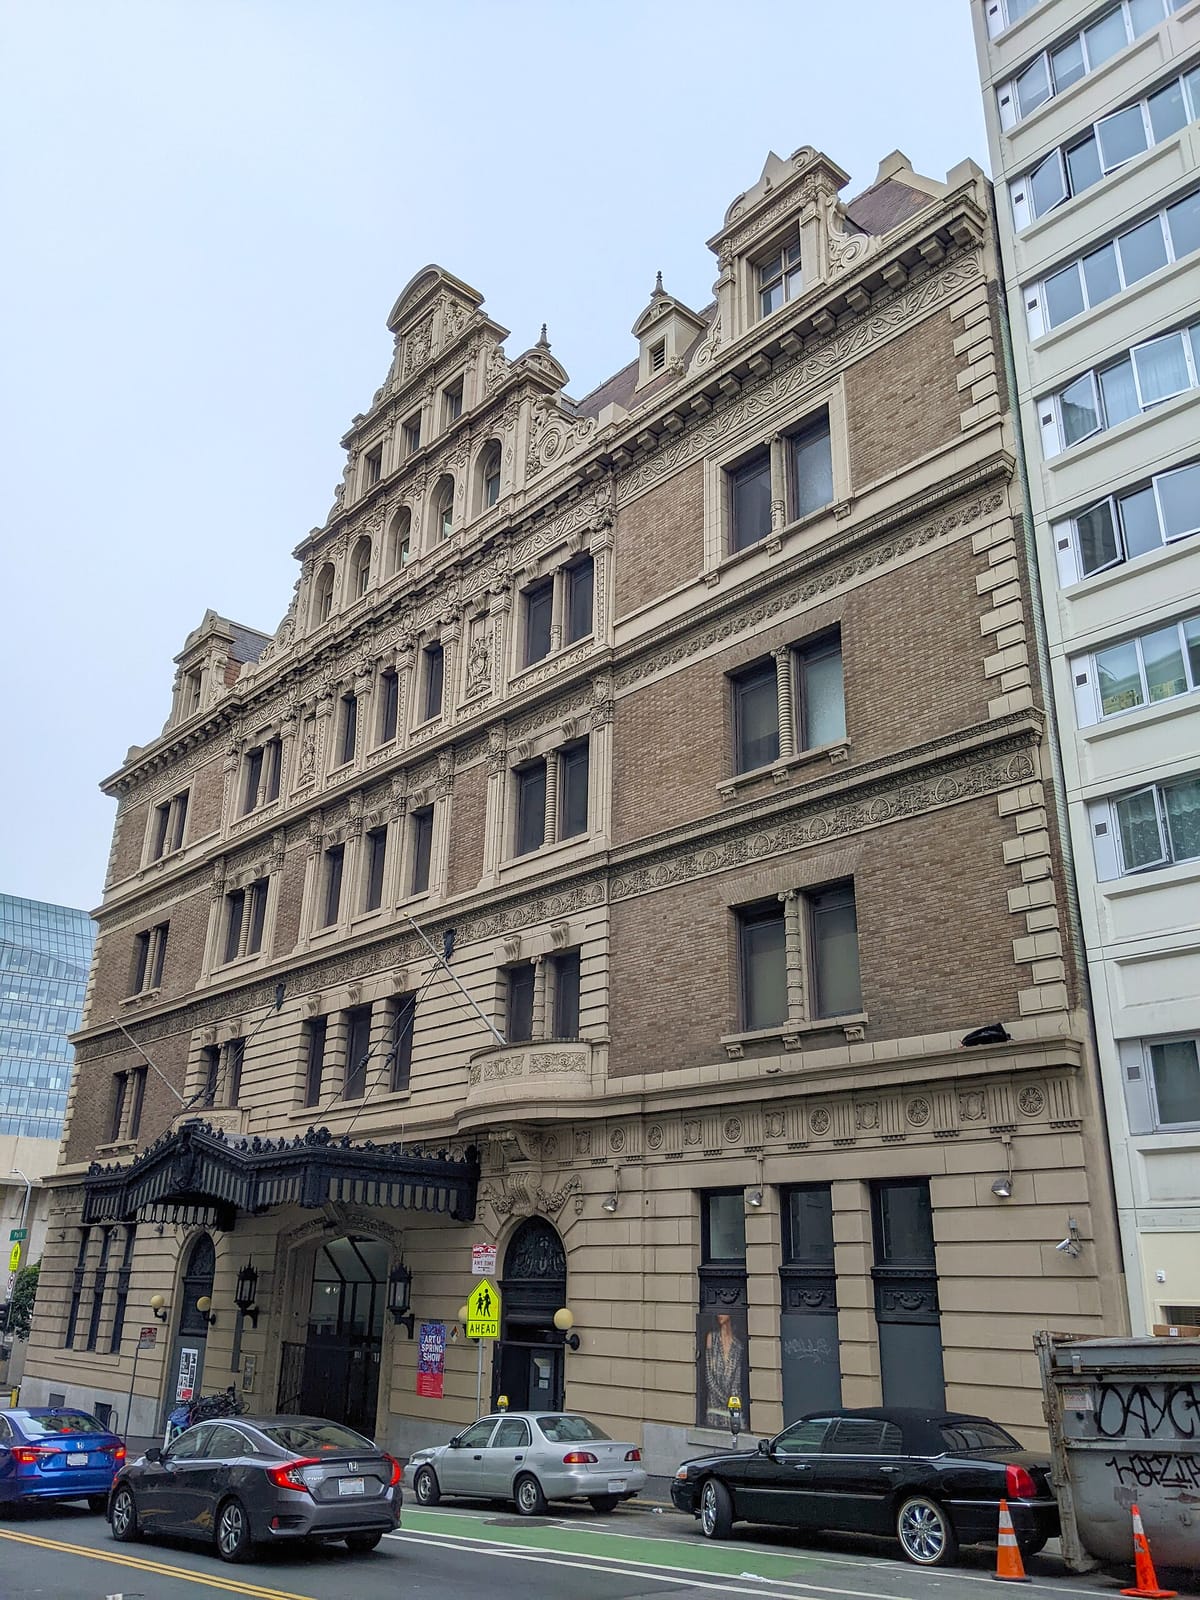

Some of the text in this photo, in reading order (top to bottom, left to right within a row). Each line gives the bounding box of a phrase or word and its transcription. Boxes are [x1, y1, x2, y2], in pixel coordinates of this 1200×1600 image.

[470, 1323, 496, 1334] AHEAD
[424, 1335, 441, 1344] ART U
[421, 1344, 443, 1353] SPRING
[422, 1352, 441, 1361] SHOW
